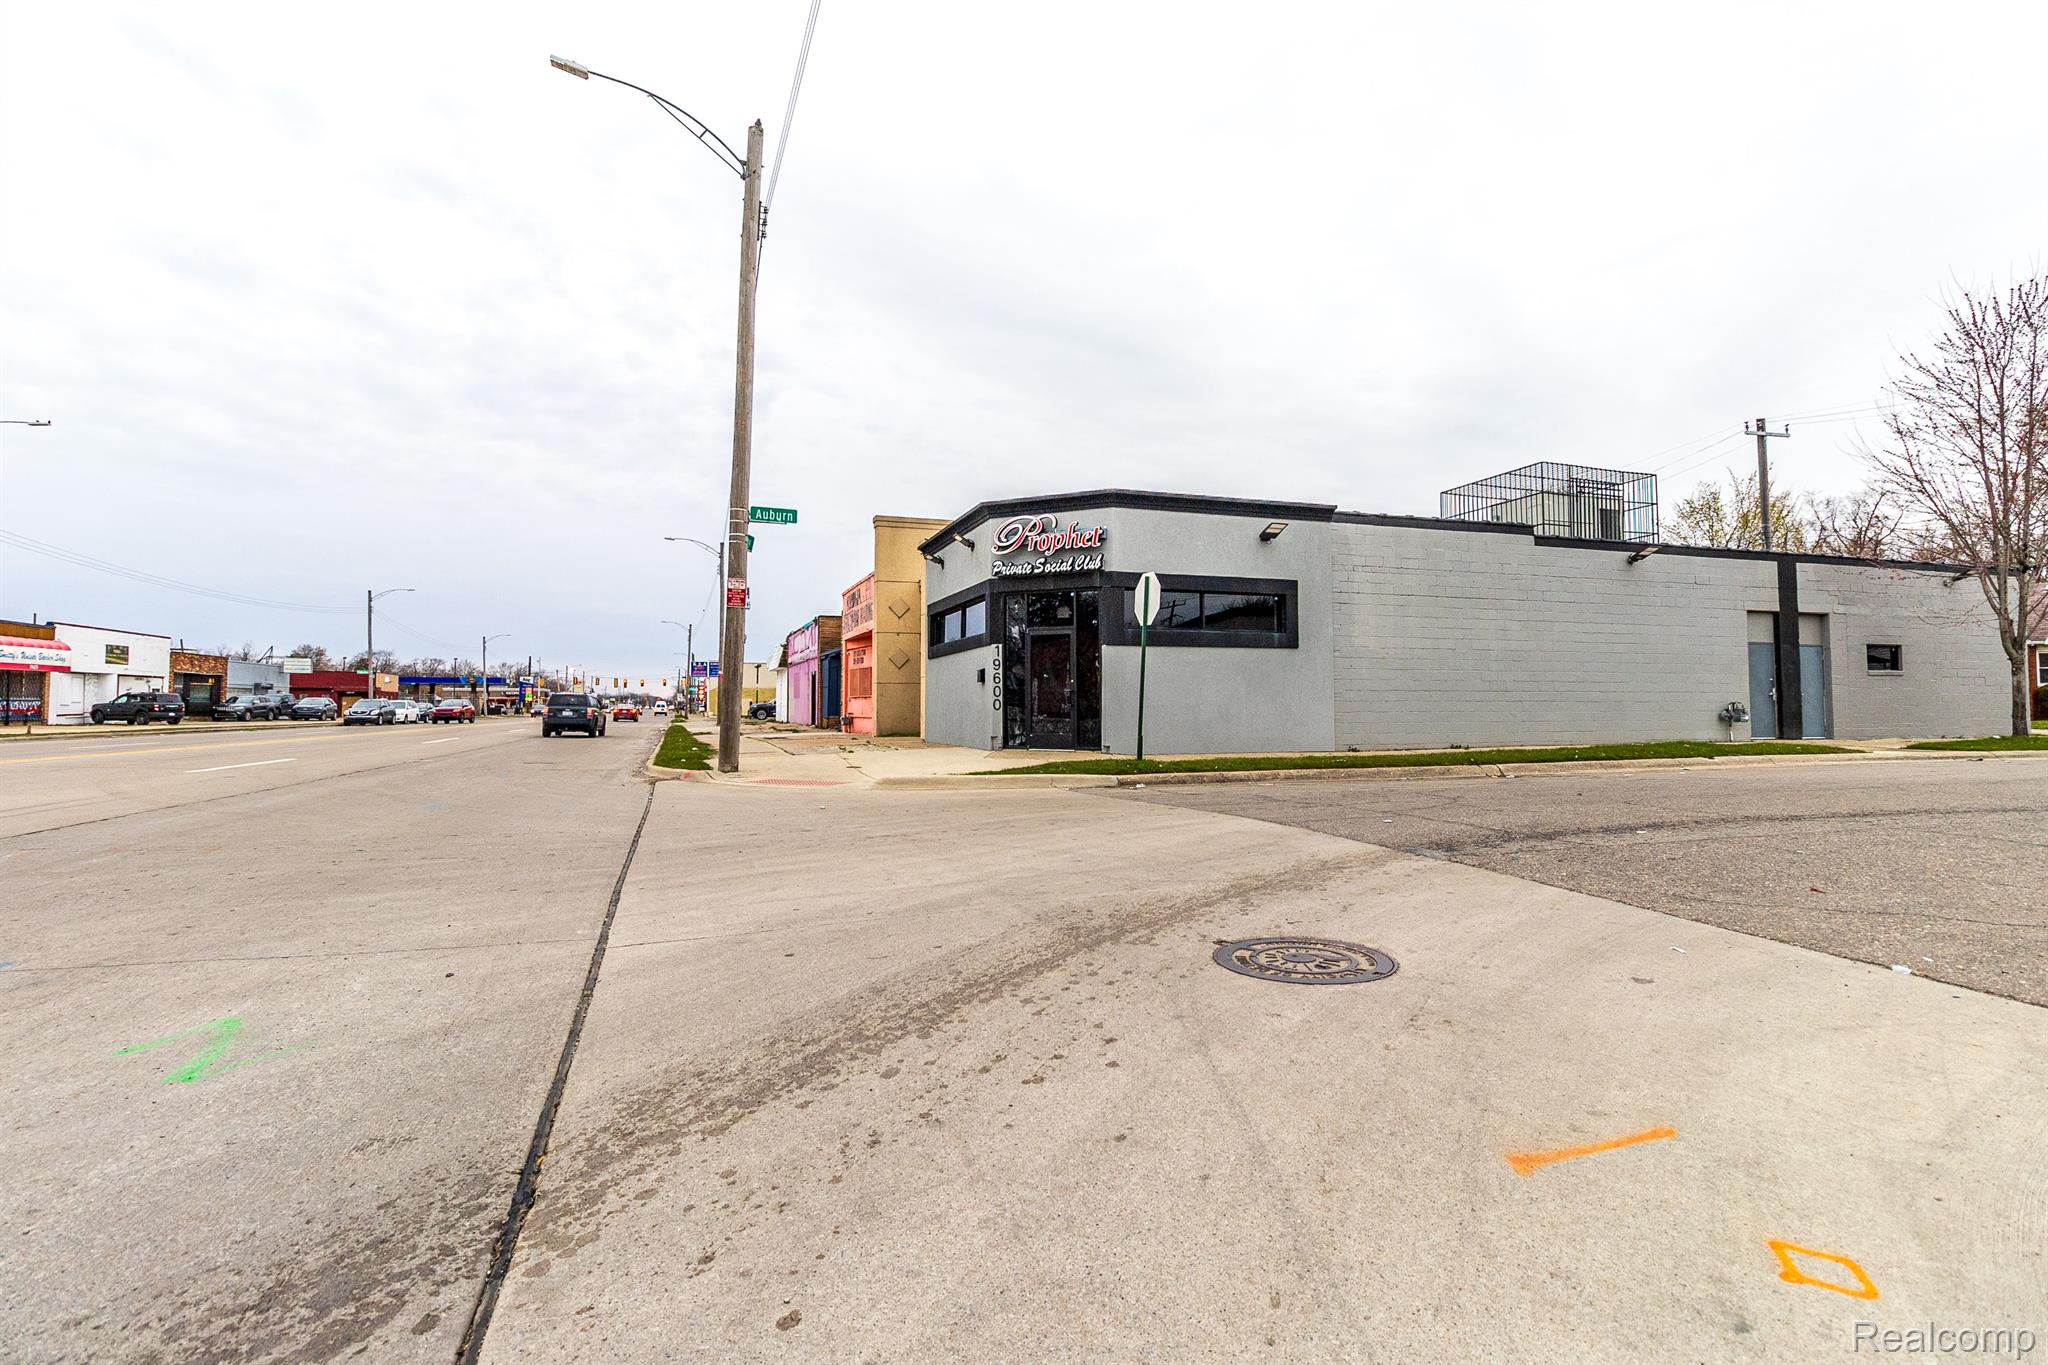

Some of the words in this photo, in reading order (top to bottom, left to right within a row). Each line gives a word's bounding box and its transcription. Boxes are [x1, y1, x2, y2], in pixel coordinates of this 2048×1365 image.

[755, 509, 793, 522] Auburn
[991, 513, 1103, 556] Prophet
[993, 560, 1032, 576] Private
[1034, 557, 1073, 573] Social
[1075, 554, 1103, 570] Club
[992, 645, 1002, 711] 19600
